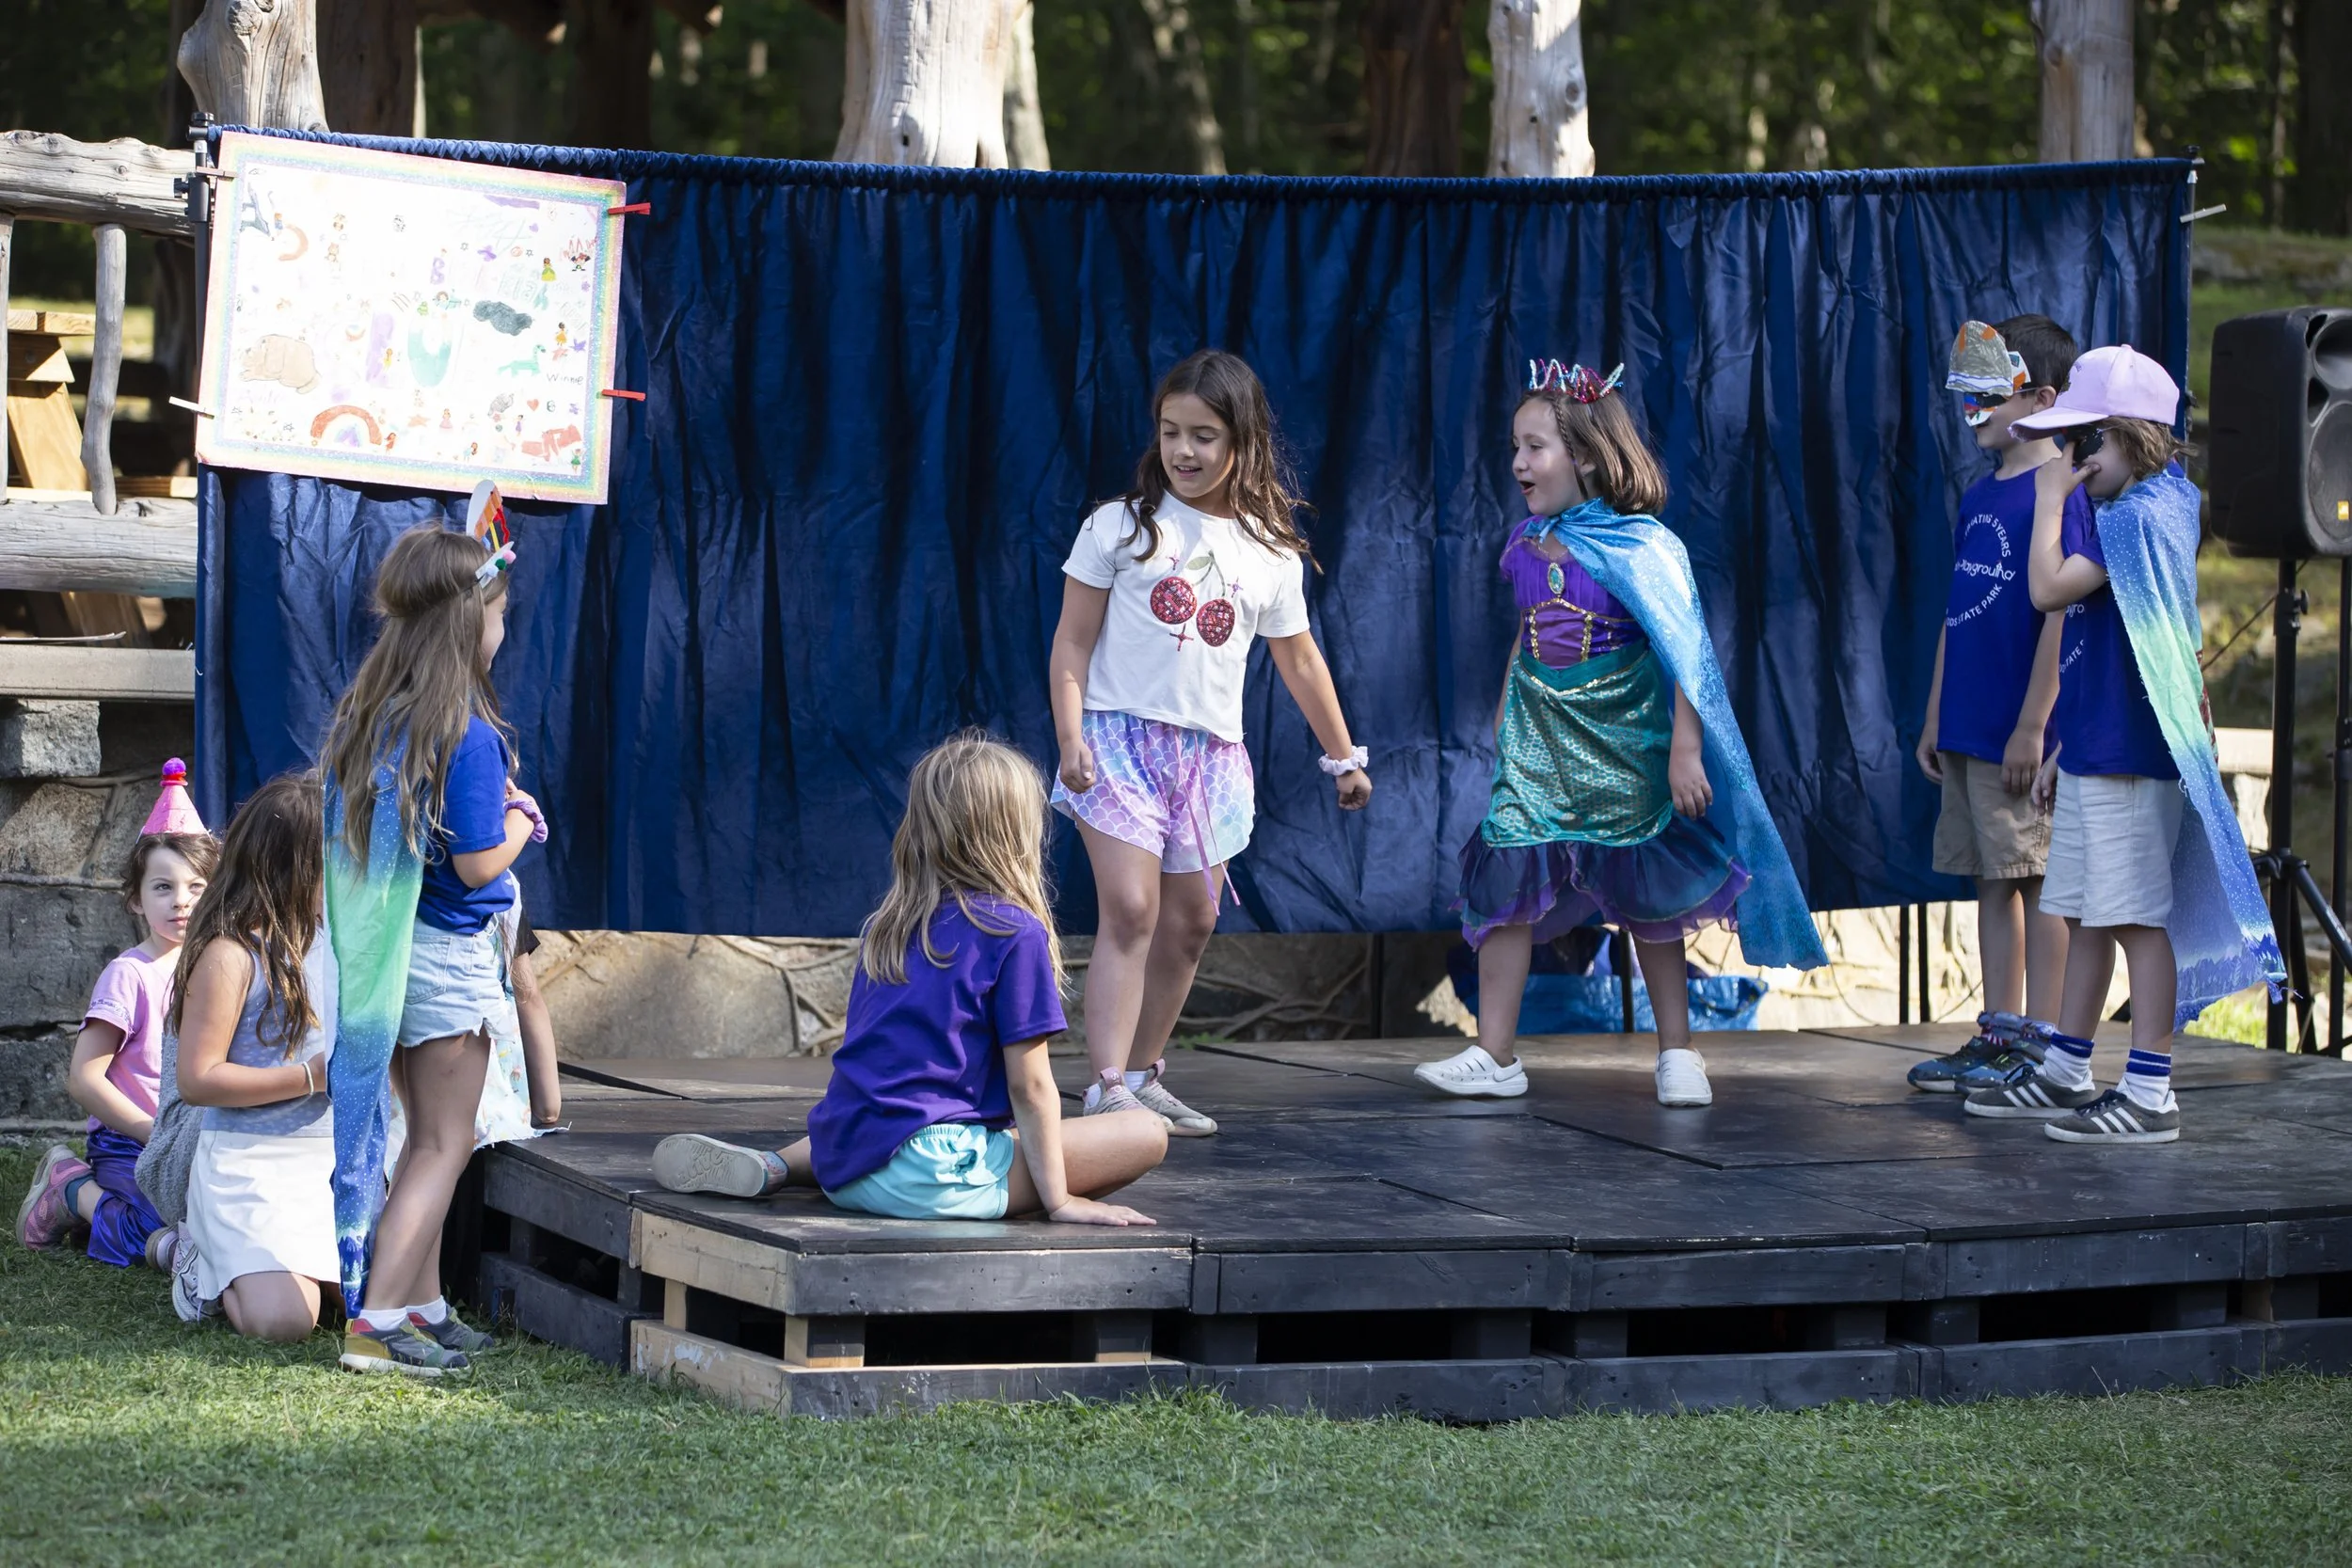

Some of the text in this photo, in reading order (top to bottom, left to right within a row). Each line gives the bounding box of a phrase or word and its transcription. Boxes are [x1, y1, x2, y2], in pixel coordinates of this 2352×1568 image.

[1992, 517, 1999, 528] 5
[1995, 523, 2011, 557] YEARS
[1980, 583, 2003, 609] PARK
